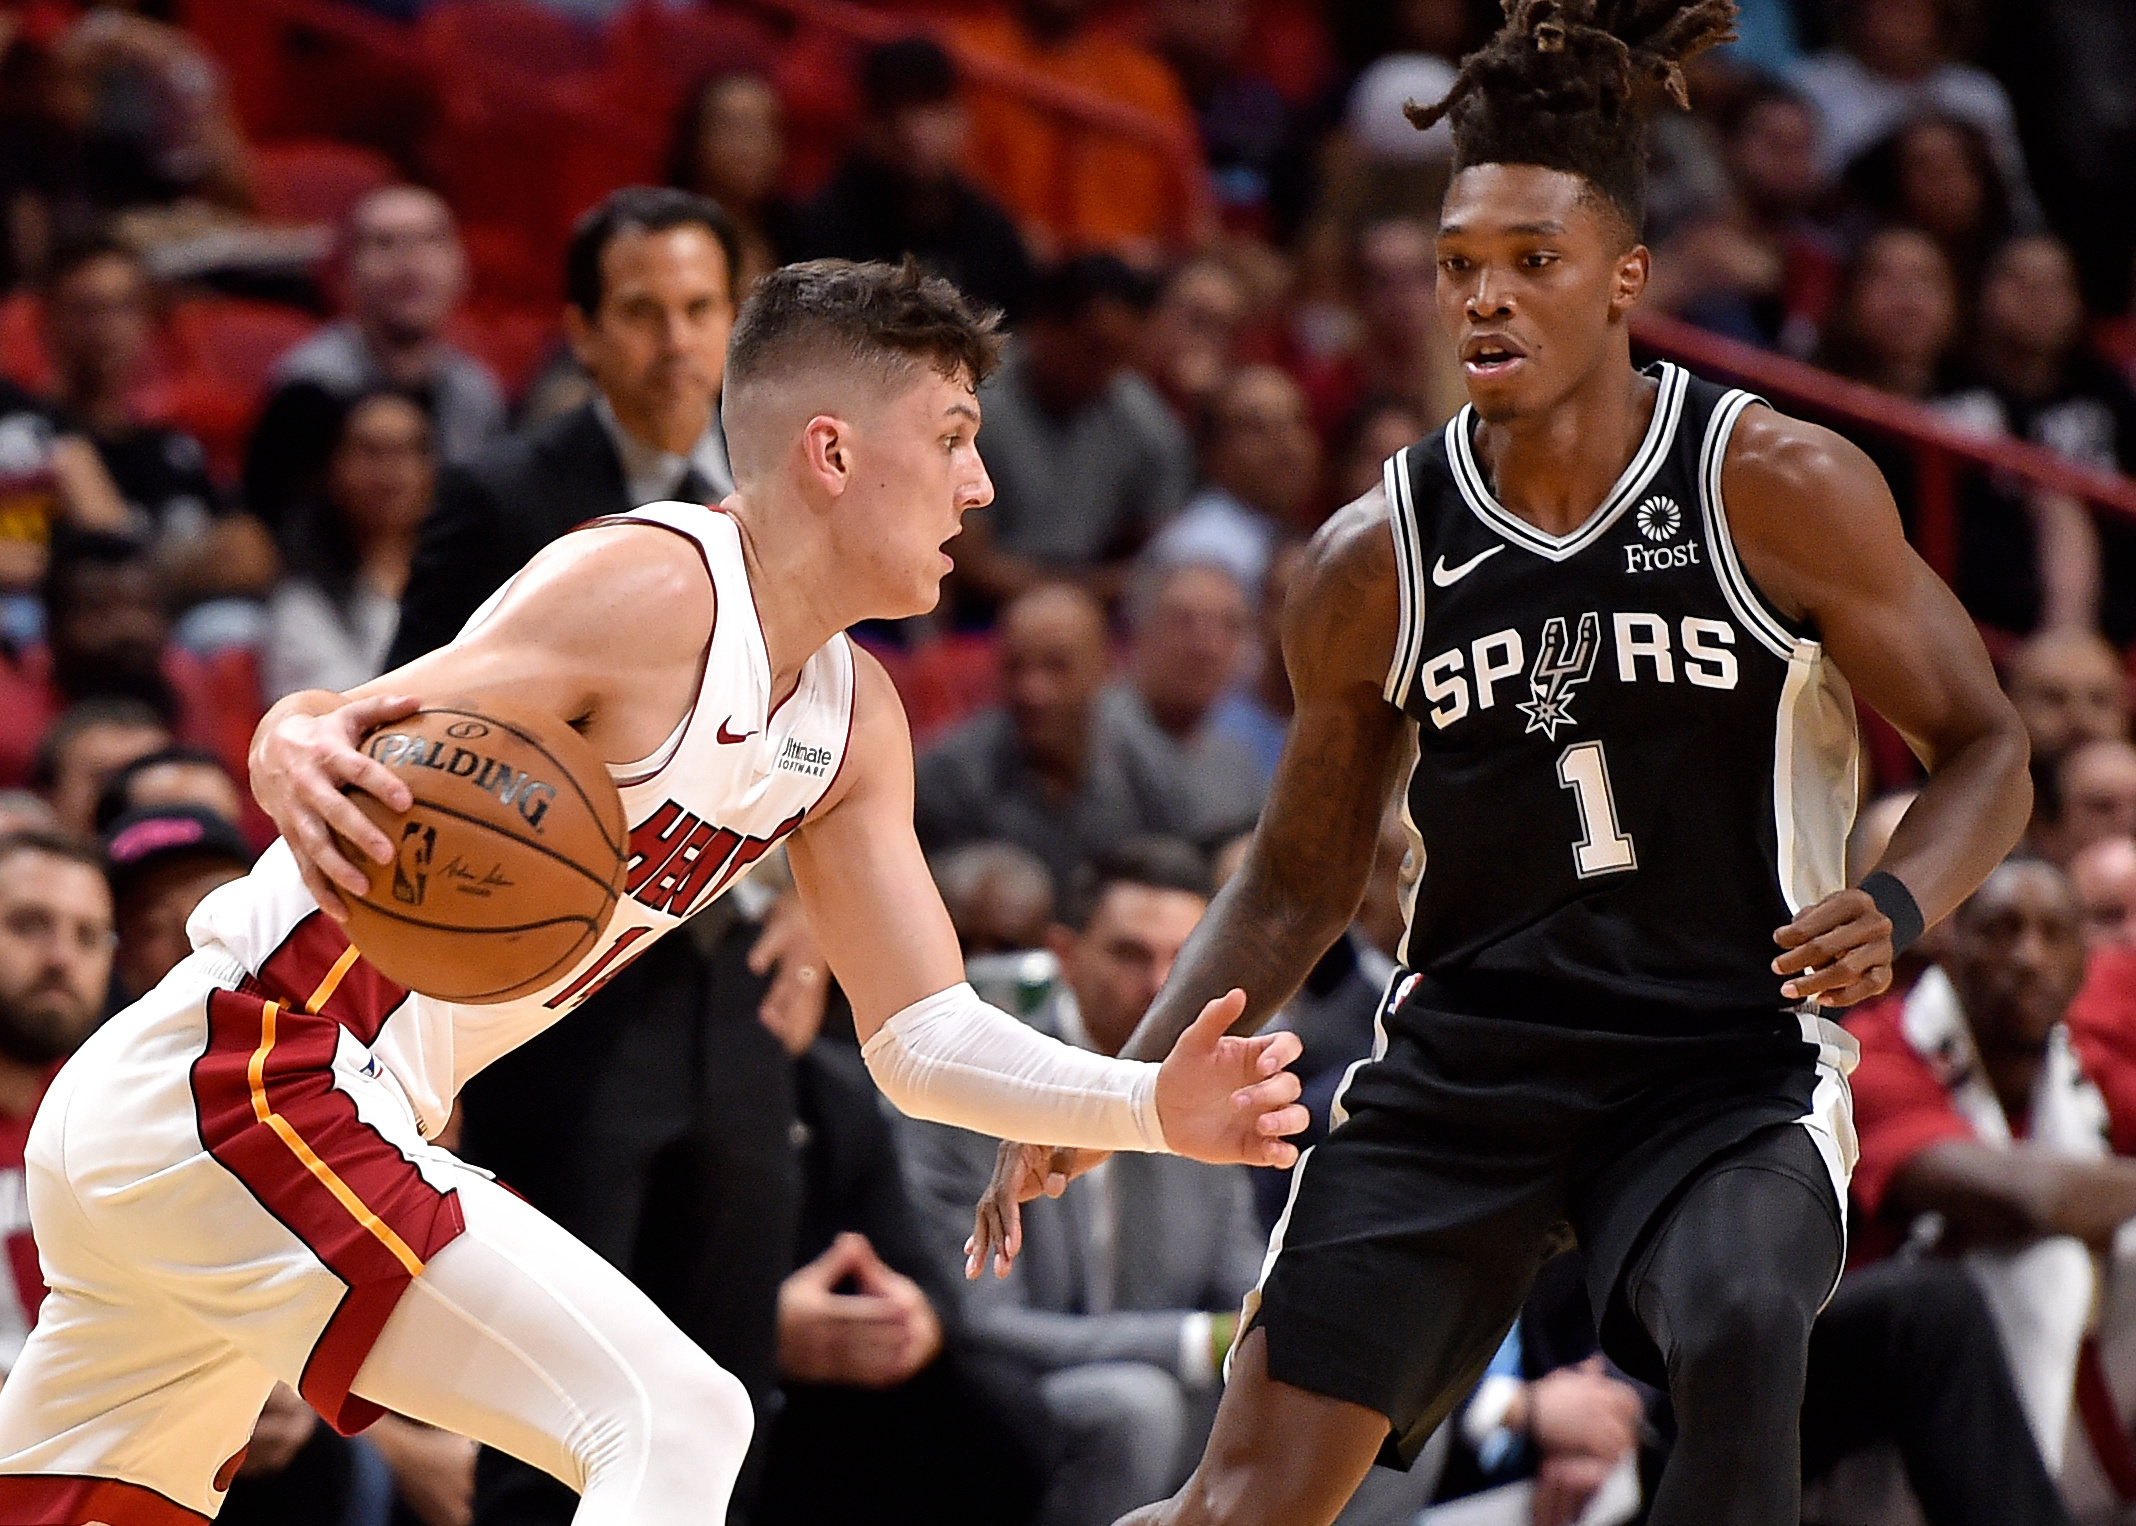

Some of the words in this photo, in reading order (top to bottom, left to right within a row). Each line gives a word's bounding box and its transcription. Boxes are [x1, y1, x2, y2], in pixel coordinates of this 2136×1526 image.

[1623, 538, 1701, 574] Frost
[1421, 611, 1739, 742] SPURS
[1556, 740, 1638, 879] 1
[542, 926, 655, 1010] 1
